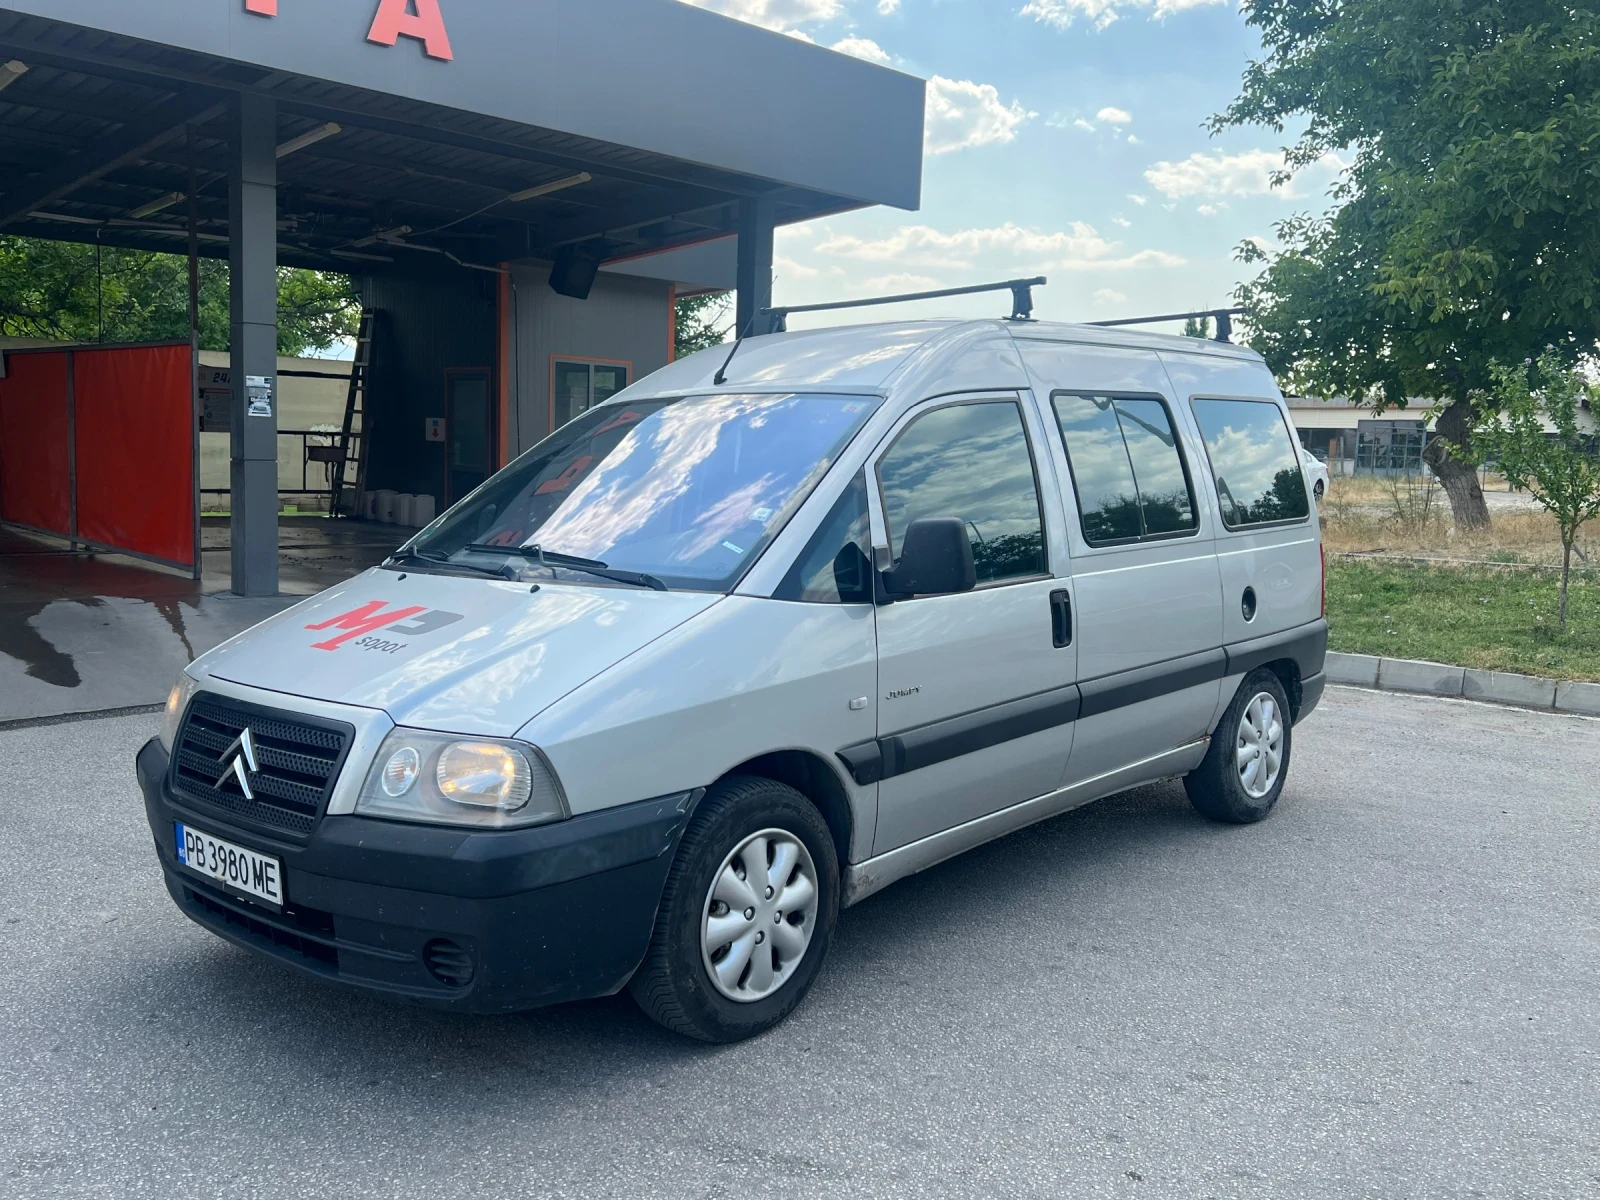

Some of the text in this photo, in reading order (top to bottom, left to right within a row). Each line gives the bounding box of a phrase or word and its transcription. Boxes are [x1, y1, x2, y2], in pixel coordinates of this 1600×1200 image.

[355, 637, 407, 653] sopot
[186, 831, 277, 898] PB 3980 ME
